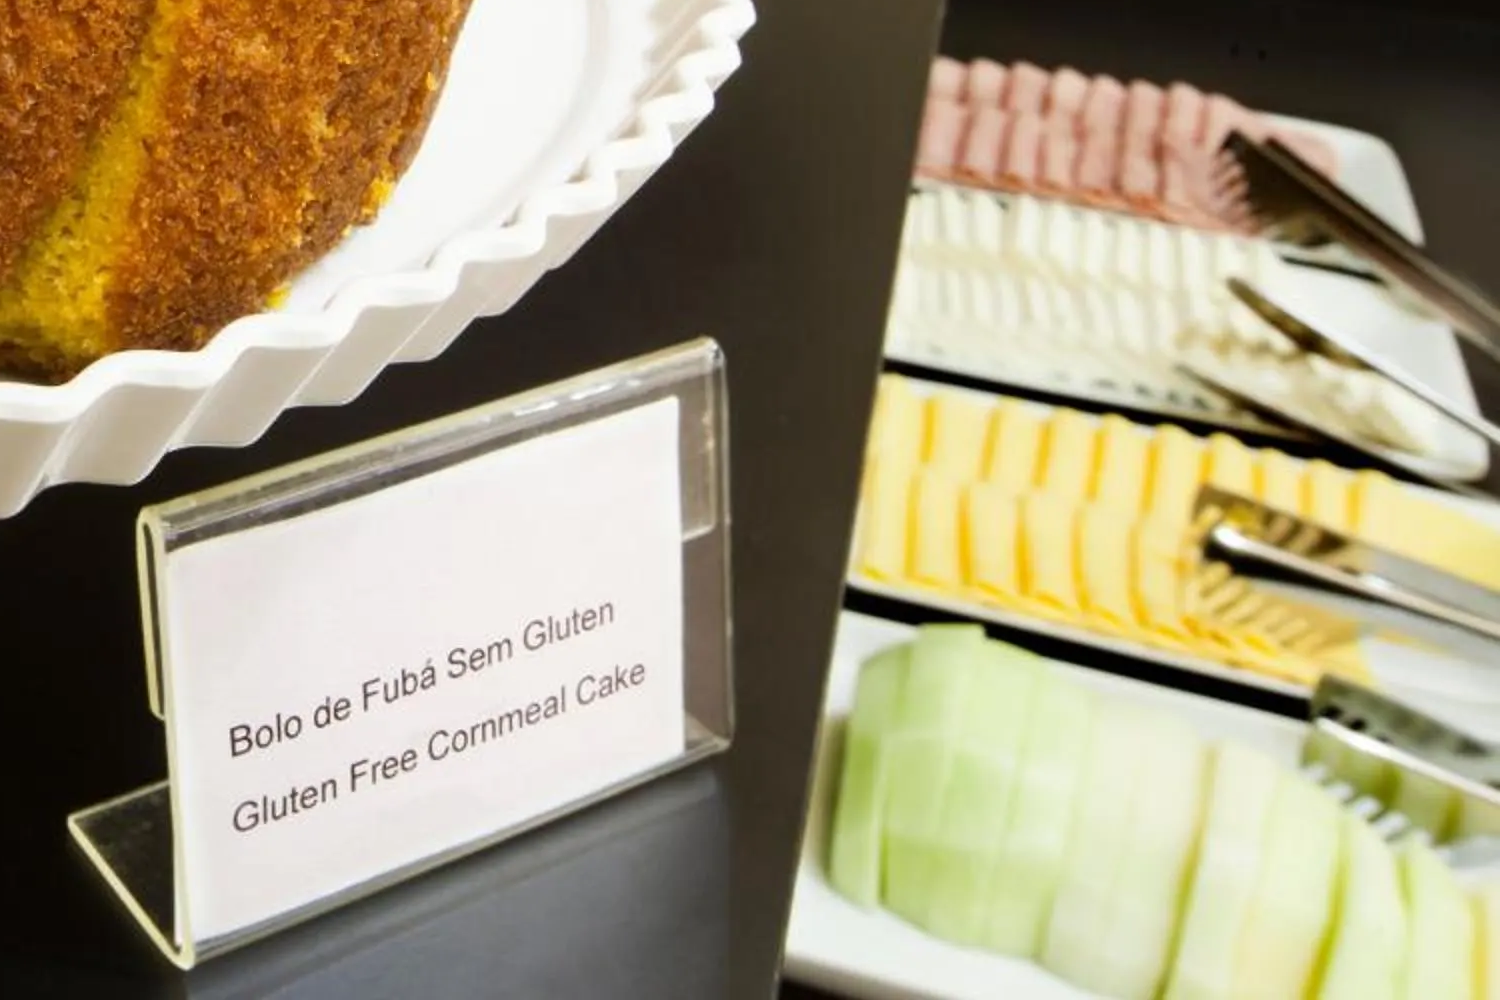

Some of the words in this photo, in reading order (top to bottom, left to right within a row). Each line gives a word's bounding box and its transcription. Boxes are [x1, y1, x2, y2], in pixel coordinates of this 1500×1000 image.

[228, 711, 302, 757] Bolo
[313, 697, 351, 729] de
[362, 657, 437, 711] Fubá
[446, 636, 513, 680] Sem
[522, 600, 615, 651] Gluten
[232, 778, 337, 833] Gluten
[349, 746, 418, 793] Free
[427, 686, 566, 762] Cornmeal
[575, 661, 646, 707] Cake
